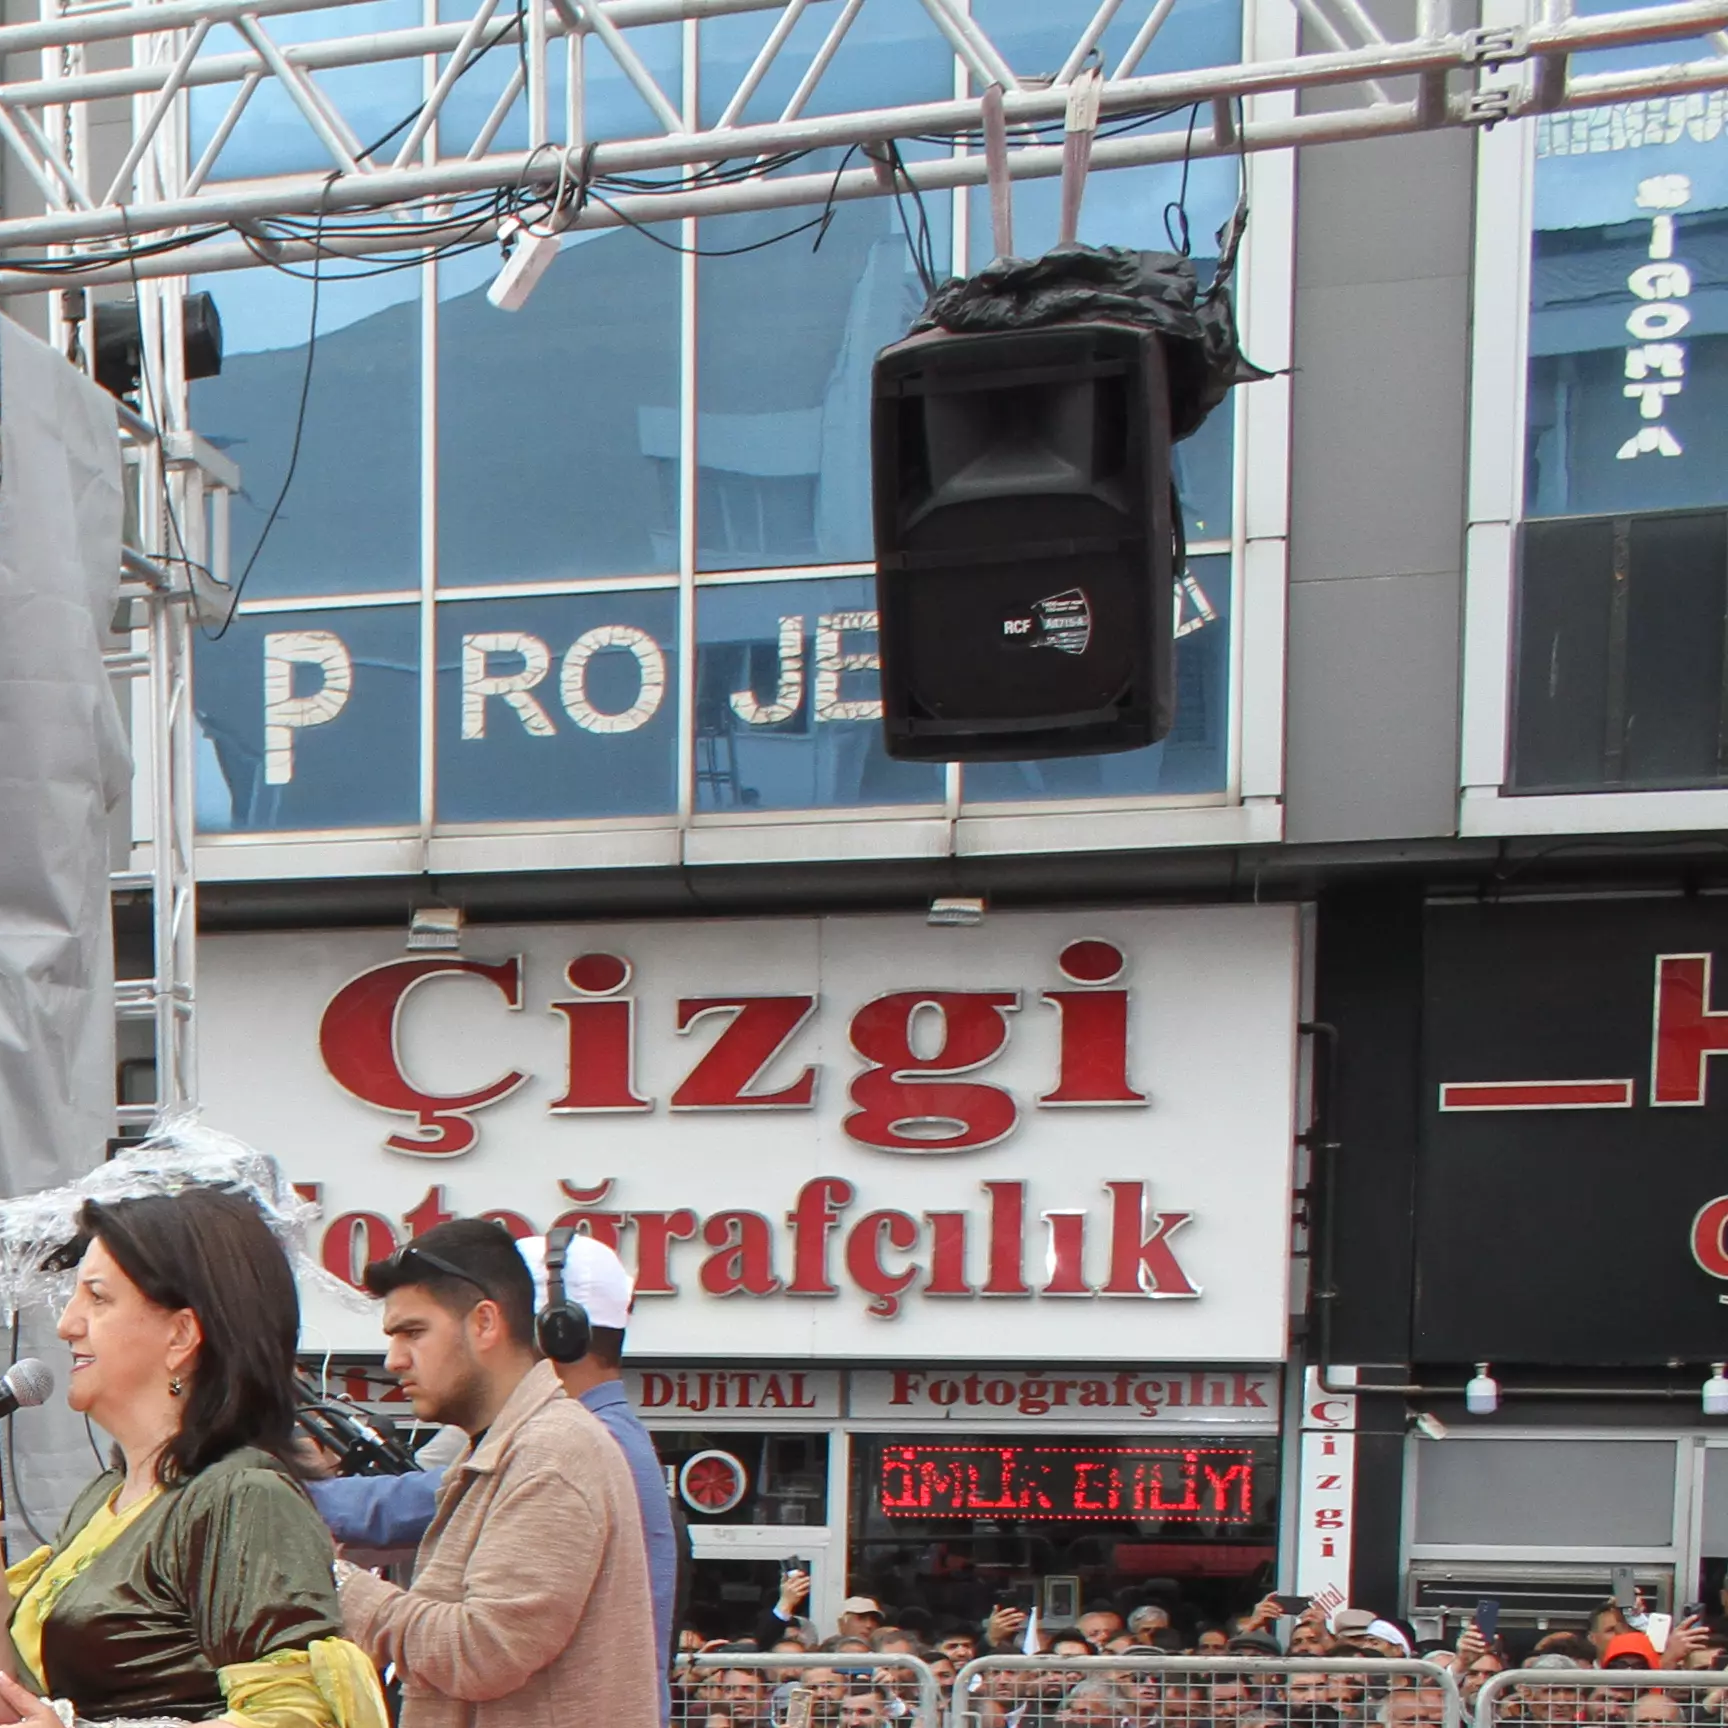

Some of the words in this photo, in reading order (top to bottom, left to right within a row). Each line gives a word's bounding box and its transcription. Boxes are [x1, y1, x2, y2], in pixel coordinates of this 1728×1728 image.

[1003, 618, 1031, 634] RCF
[319, 935, 1151, 1158] Çizgi
[890, 1368, 1267, 1416] Fotoğrafçılık
[1310, 1400, 1349, 1557] Çizgi
